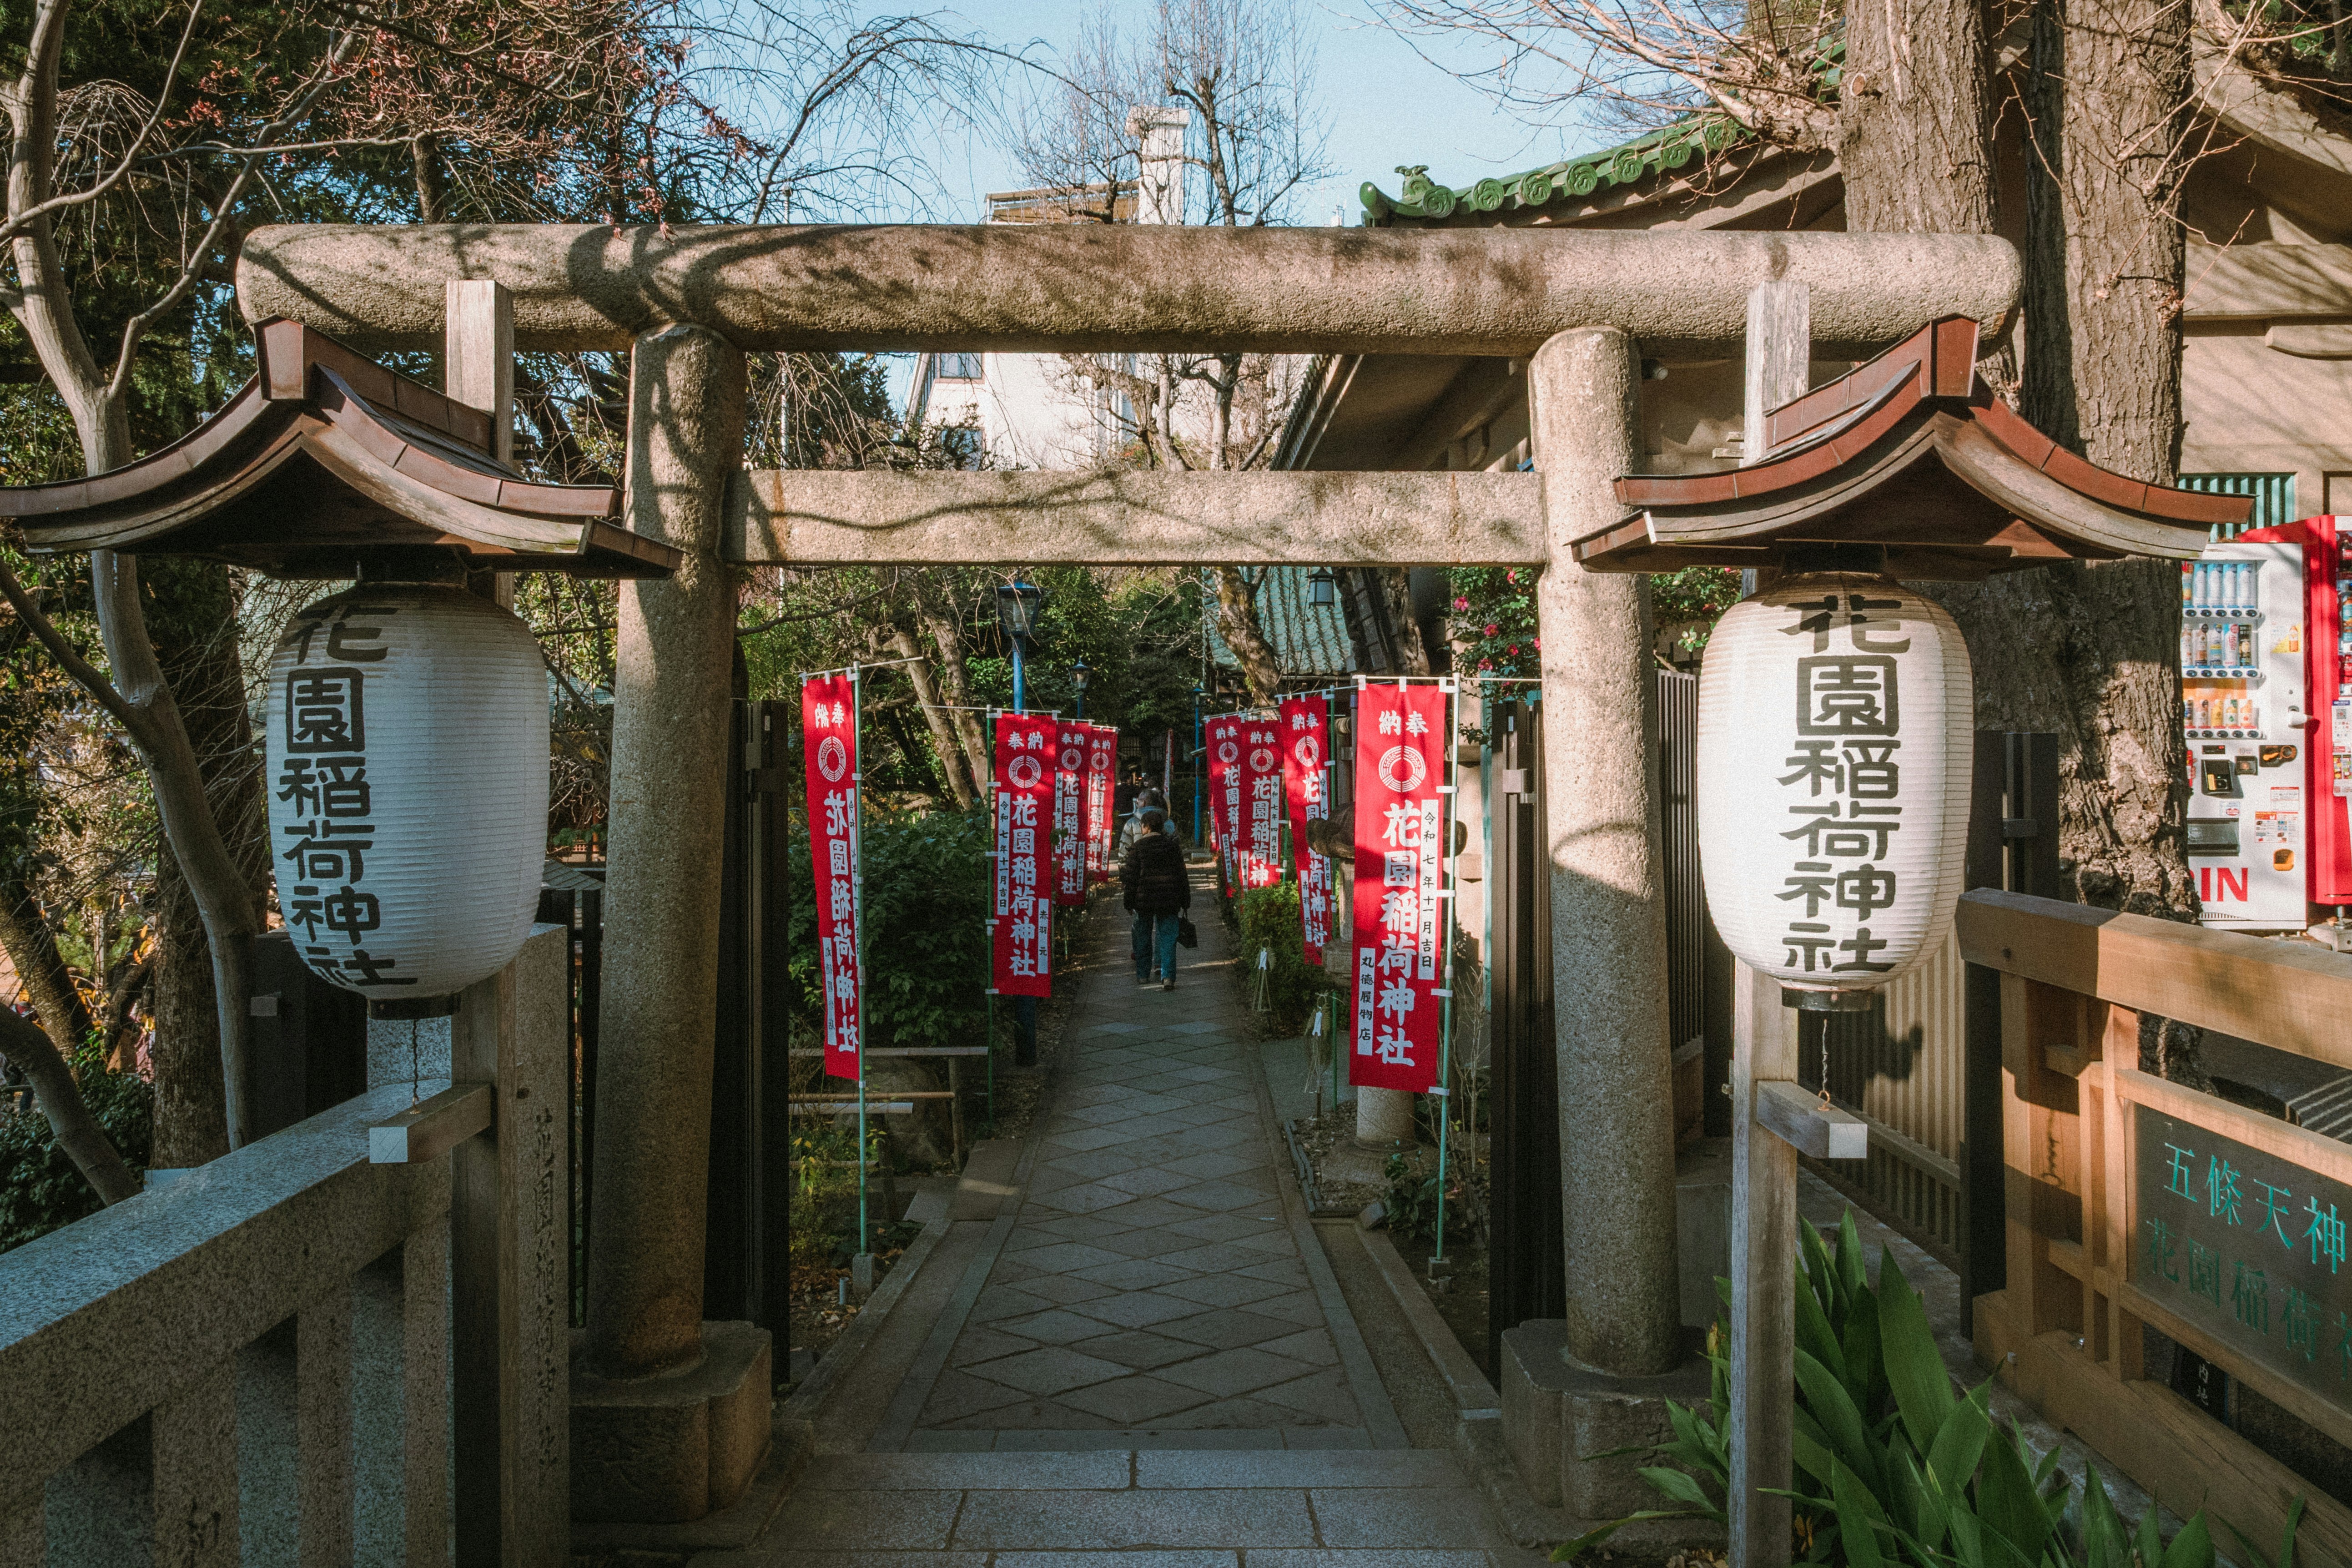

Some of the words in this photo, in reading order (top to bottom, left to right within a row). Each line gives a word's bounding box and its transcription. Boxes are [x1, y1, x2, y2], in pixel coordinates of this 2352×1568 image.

[276, 607, 418, 985] 花園稲荷神社
[1007, 731, 1043, 750] 奉納
[1061, 732, 1084, 746] 奉納
[1774, 595, 1911, 973] 花園稲荷神社
[999, 801, 1009, 908] 令和七年十一月吉日
[1009, 793, 1038, 977] 花園稲荷神社
[1421, 812, 1436, 968] 令和七年十一月吉日
[2189, 867, 2248, 902] IN
[1375, 799, 1421, 1067] 花園稲荷神社
[2164, 1142, 2346, 1274] 五條天神
[2196, 1360, 2210, 1406] 内地
